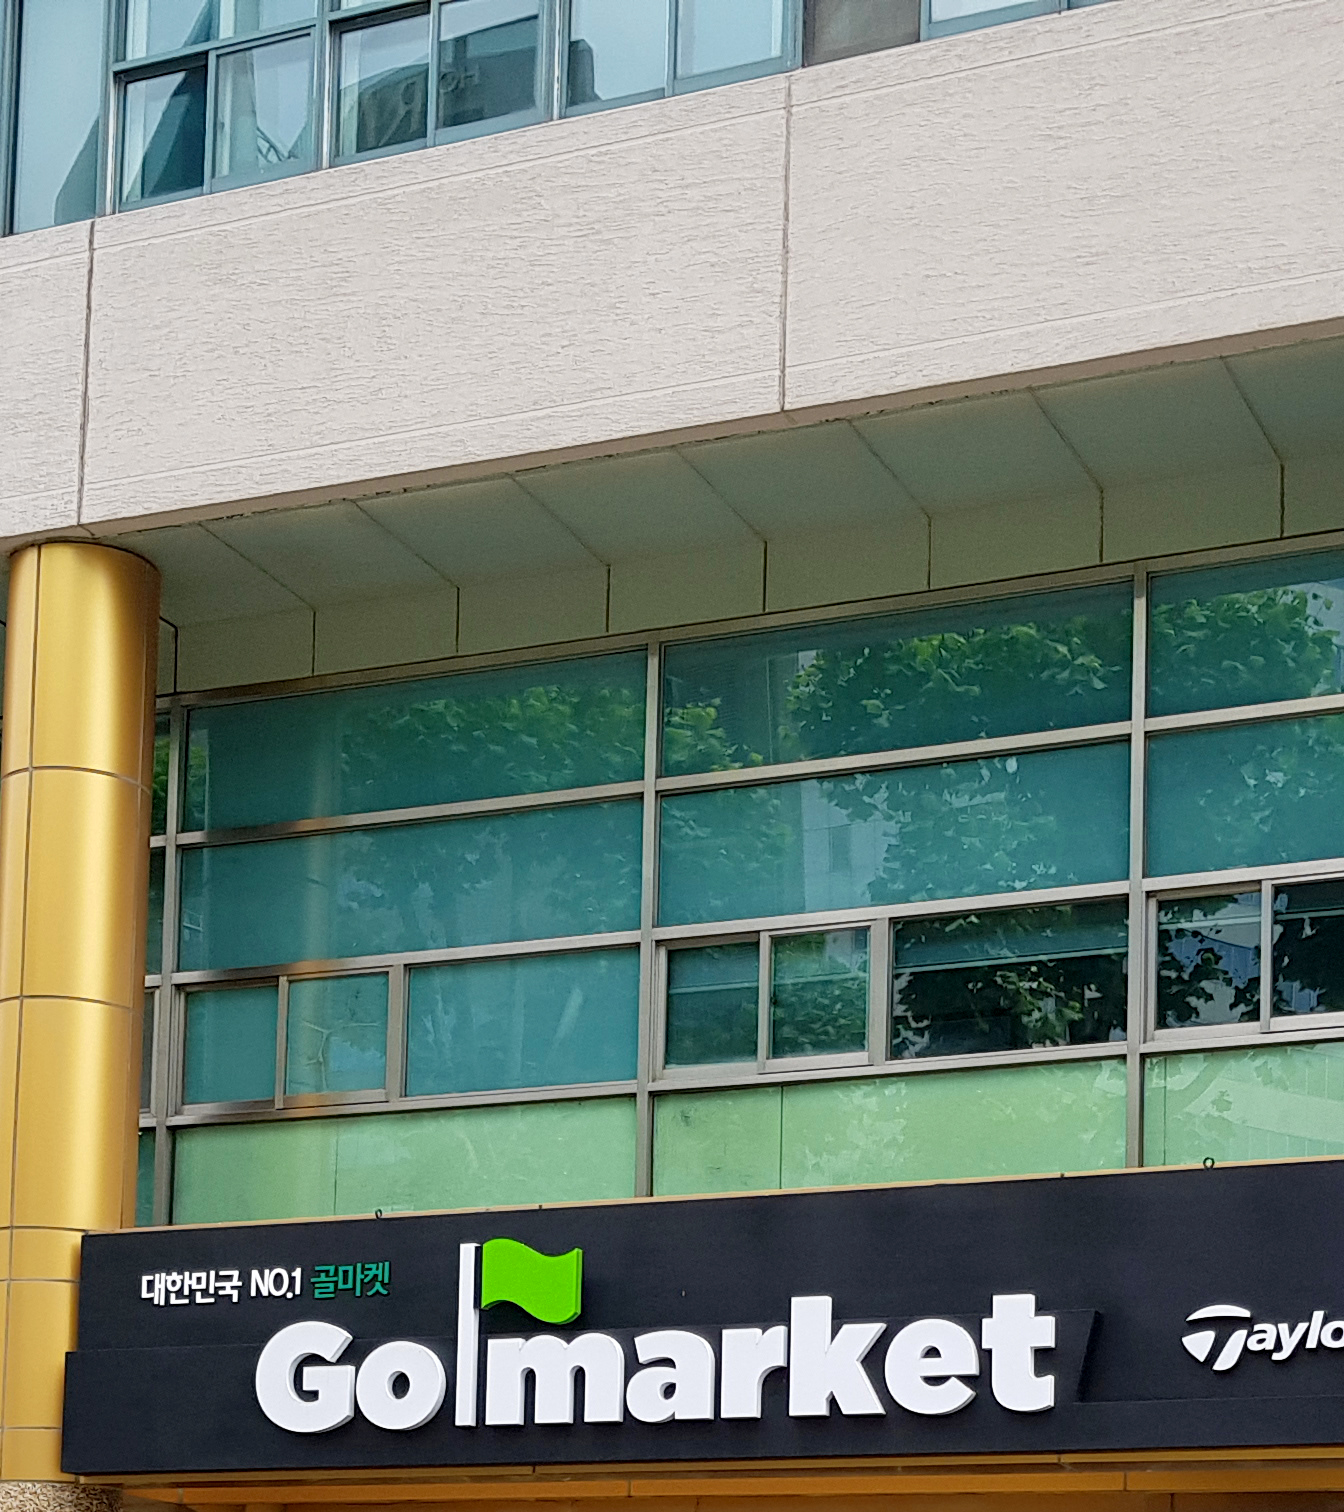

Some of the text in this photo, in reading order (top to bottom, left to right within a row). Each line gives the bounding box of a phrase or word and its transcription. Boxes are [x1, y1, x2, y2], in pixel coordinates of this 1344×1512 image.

[141, 1261, 390, 1306] 대한민국 NO.1 골마켓
